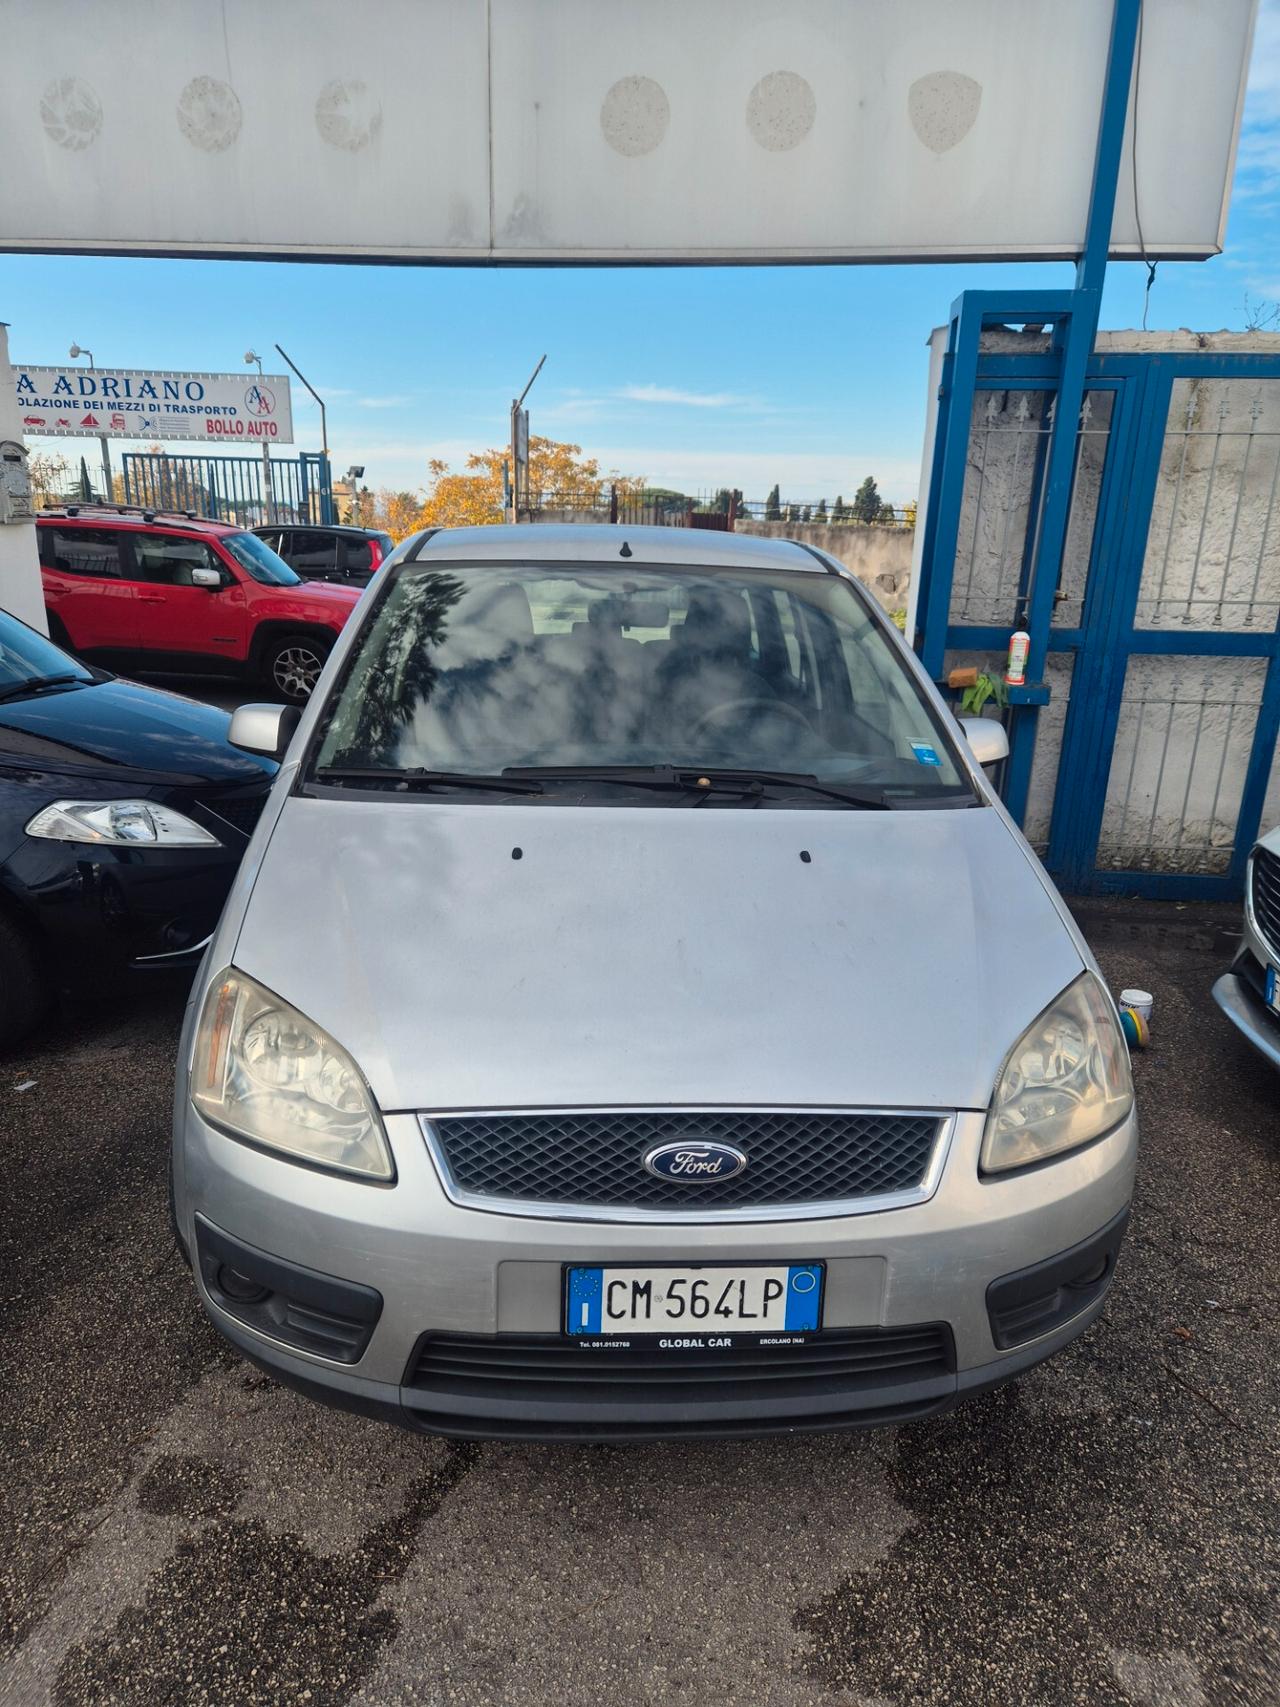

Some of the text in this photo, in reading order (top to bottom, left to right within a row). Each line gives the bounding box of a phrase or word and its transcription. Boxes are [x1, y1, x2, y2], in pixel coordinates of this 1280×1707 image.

[53, 375, 204, 401] ADRIANO
[84, 400, 103, 410] DEI
[107, 401, 145, 412] MEZZI
[149, 403, 160, 413] DI
[164, 404, 237, 415] TRASPORTO
[206, 419, 244, 434] BOLLO
[247, 421, 278, 436] AUTO
[670, 1151, 723, 1174] Ford
[659, 1338, 732, 1348] GLOBAL CAR
